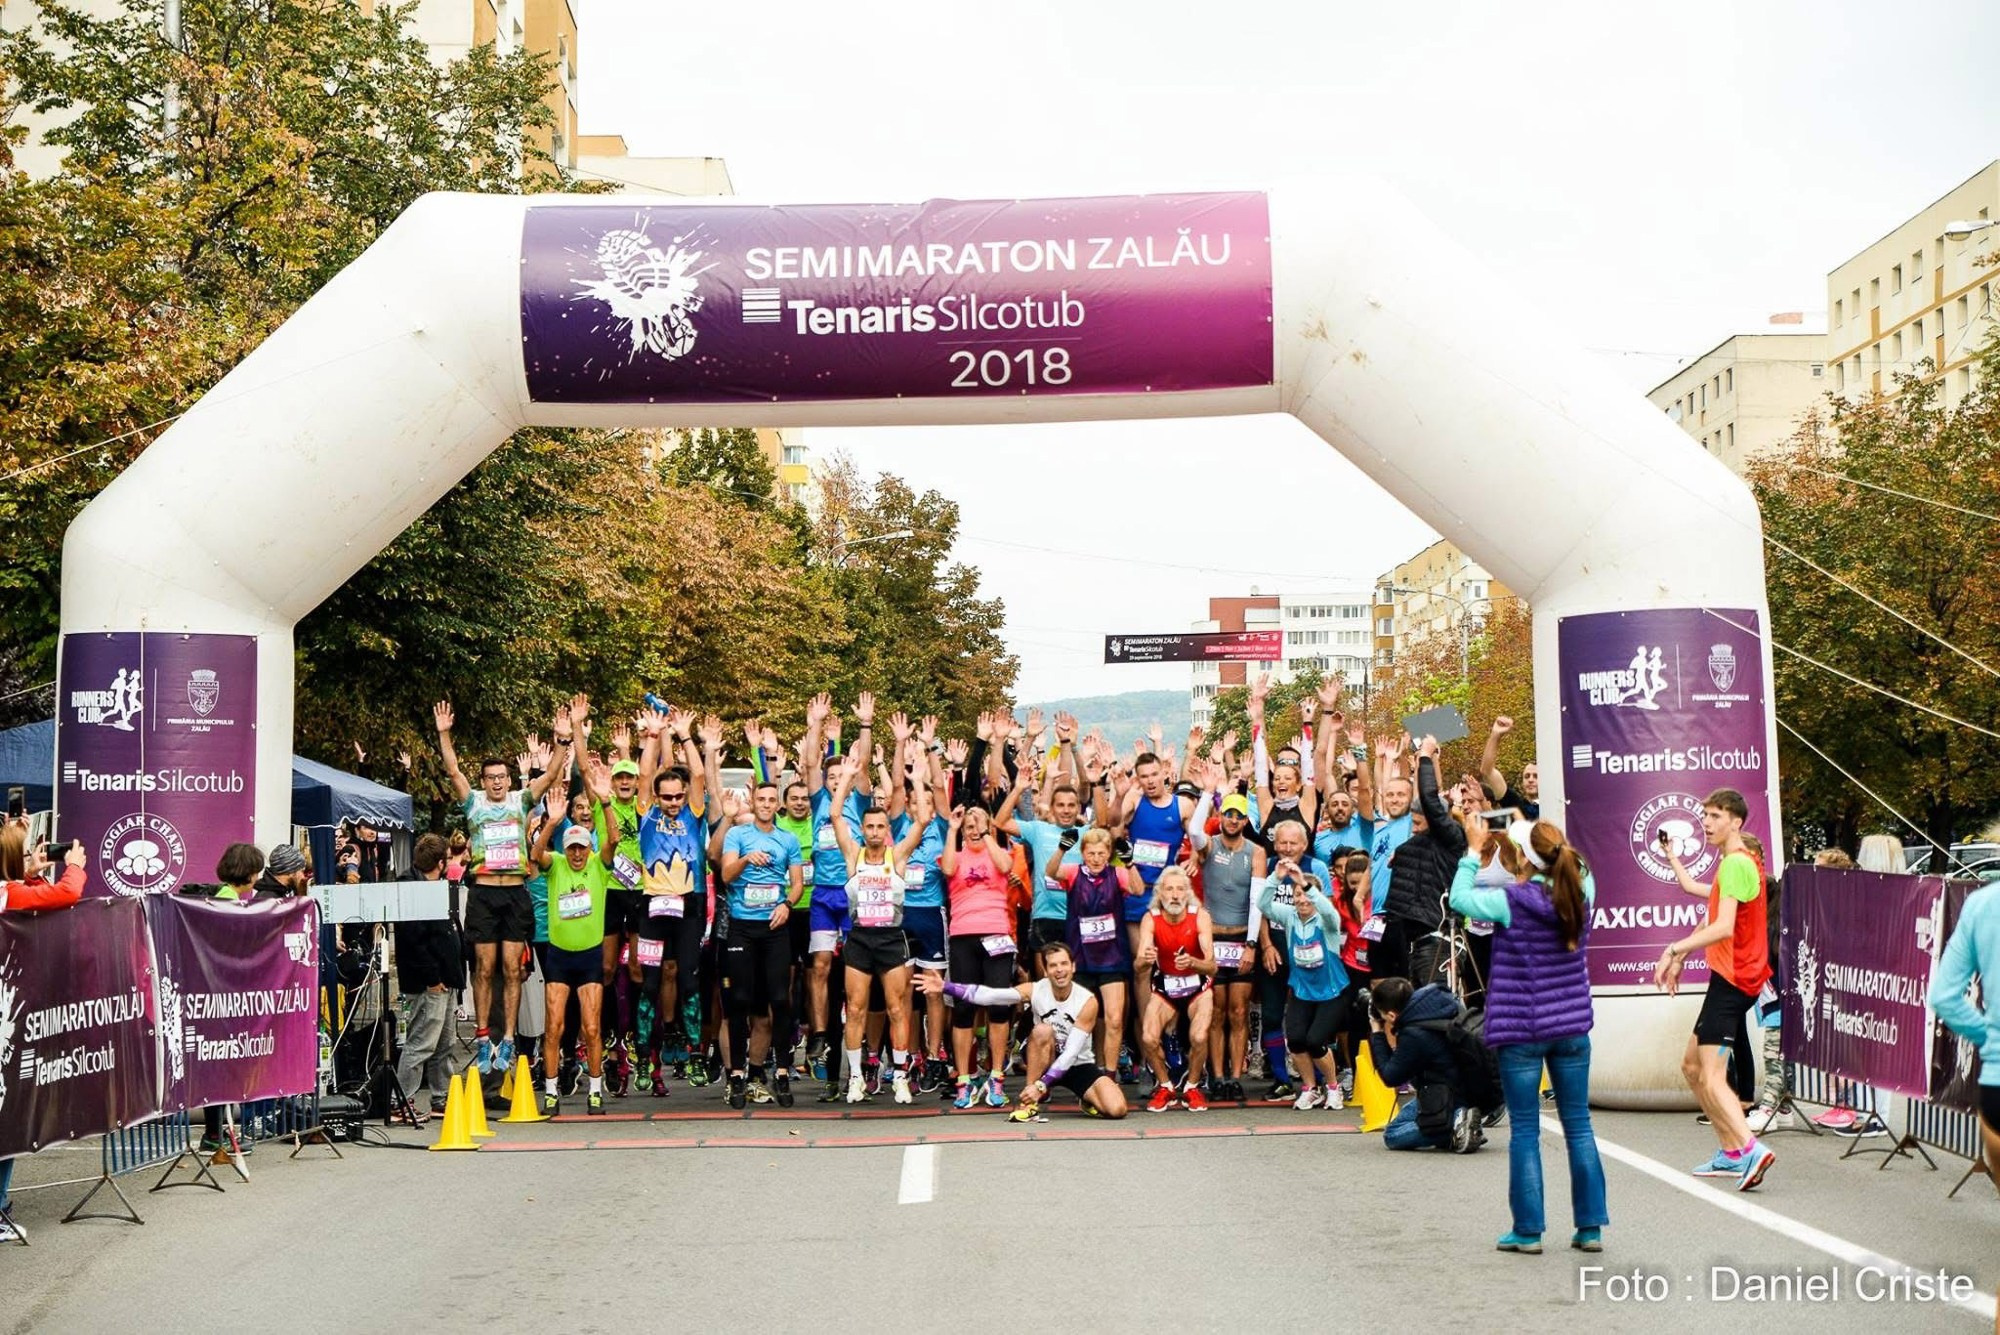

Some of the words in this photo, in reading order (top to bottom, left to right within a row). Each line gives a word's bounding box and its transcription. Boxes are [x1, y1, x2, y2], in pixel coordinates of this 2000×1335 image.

[744, 239, 1076, 280] SEMIMARATON
[1087, 229, 1231, 270] ZALĂU
[787, 291, 1086, 336] TenarisSilcotub
[949, 346, 1073, 388] 2018
[1579, 669, 1635, 691] RUNNERS
[71, 690, 116, 709] RUNNERS
[1590, 687, 1618, 706] CLUB
[78, 706, 102, 723] CLUB
[1596, 745, 1761, 774] TenarisSilcotub
[78, 767, 244, 794] TenarisSilcotub
[1633, 796, 1679, 842] BOGLAR
[102, 816, 145, 859] BOGLAR
[150, 818, 183, 865] CHAMP
[618, 860, 637, 878] 175
[662, 899, 669, 907] 9
[867, 891, 886, 902] 198
[1091, 922, 1106, 933] 33
[1217, 948, 1239, 959] 120
[1824, 961, 1900, 1000] SEMIMARATON
[24, 1000, 113, 1043] SEMIMARATON
[113, 986, 145, 1024] ZALĂU
[186, 989, 276, 1021] SEMIMARATON
[276, 982, 311, 1013] ZALĂU
[1832, 1002, 1898, 1046] TenarisSilcotub
[196, 1028, 275, 1062] TenarisSilcotub
[34, 1040, 115, 1086] TenarisSilcotub
